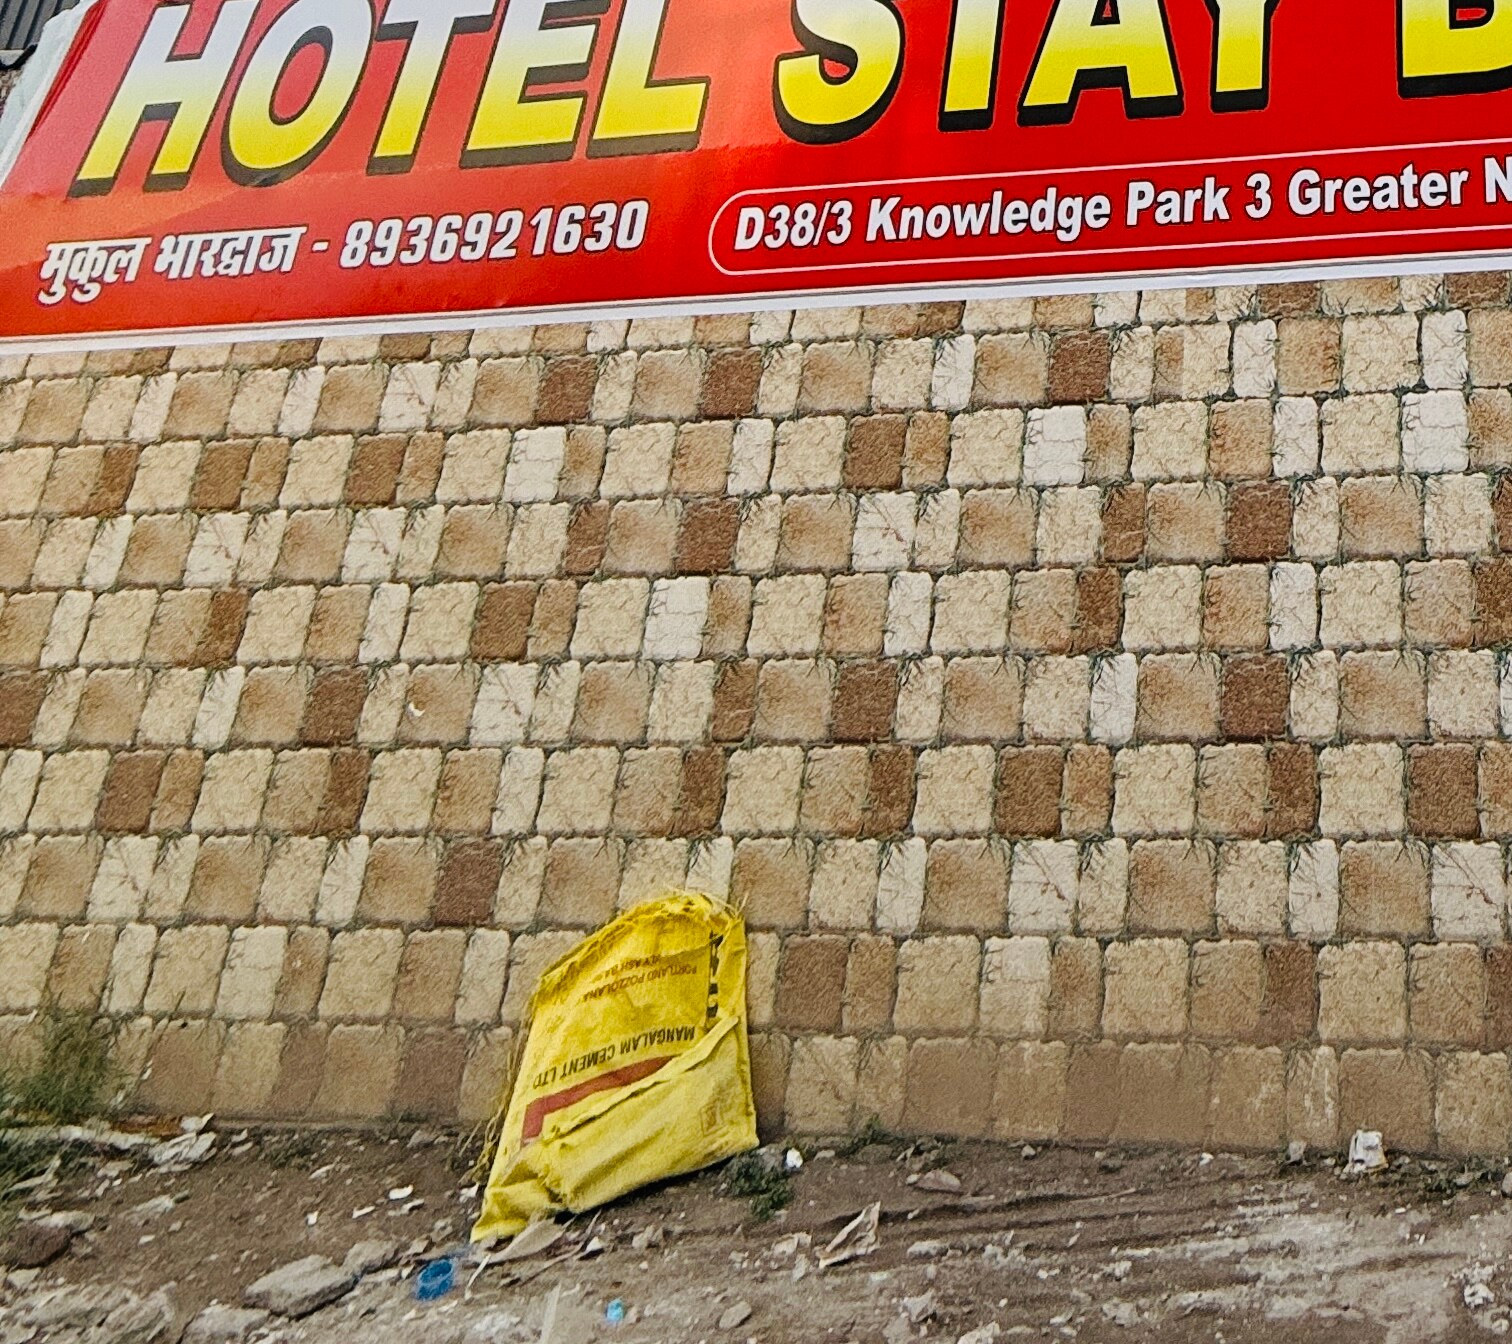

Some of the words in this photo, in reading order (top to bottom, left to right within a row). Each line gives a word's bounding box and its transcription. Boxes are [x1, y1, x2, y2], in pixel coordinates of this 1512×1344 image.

[734, 196, 852, 252] D38/3
[866, 178, 1110, 243] Knowledge
[1126, 175, 1230, 228] Park
[1245, 174, 1273, 219] 3
[1287, 162, 1471, 213] Greater
[37, 236, 152, 304] मुकुल
[153, 224, 308, 280] भारद्वाज
[340, 200, 649, 269] 8936921630
[620, 1026, 695, 1054] MANGALAM
[533, 1066, 557, 1089] LTD
[560, 1044, 616, 1080] CEMENT
